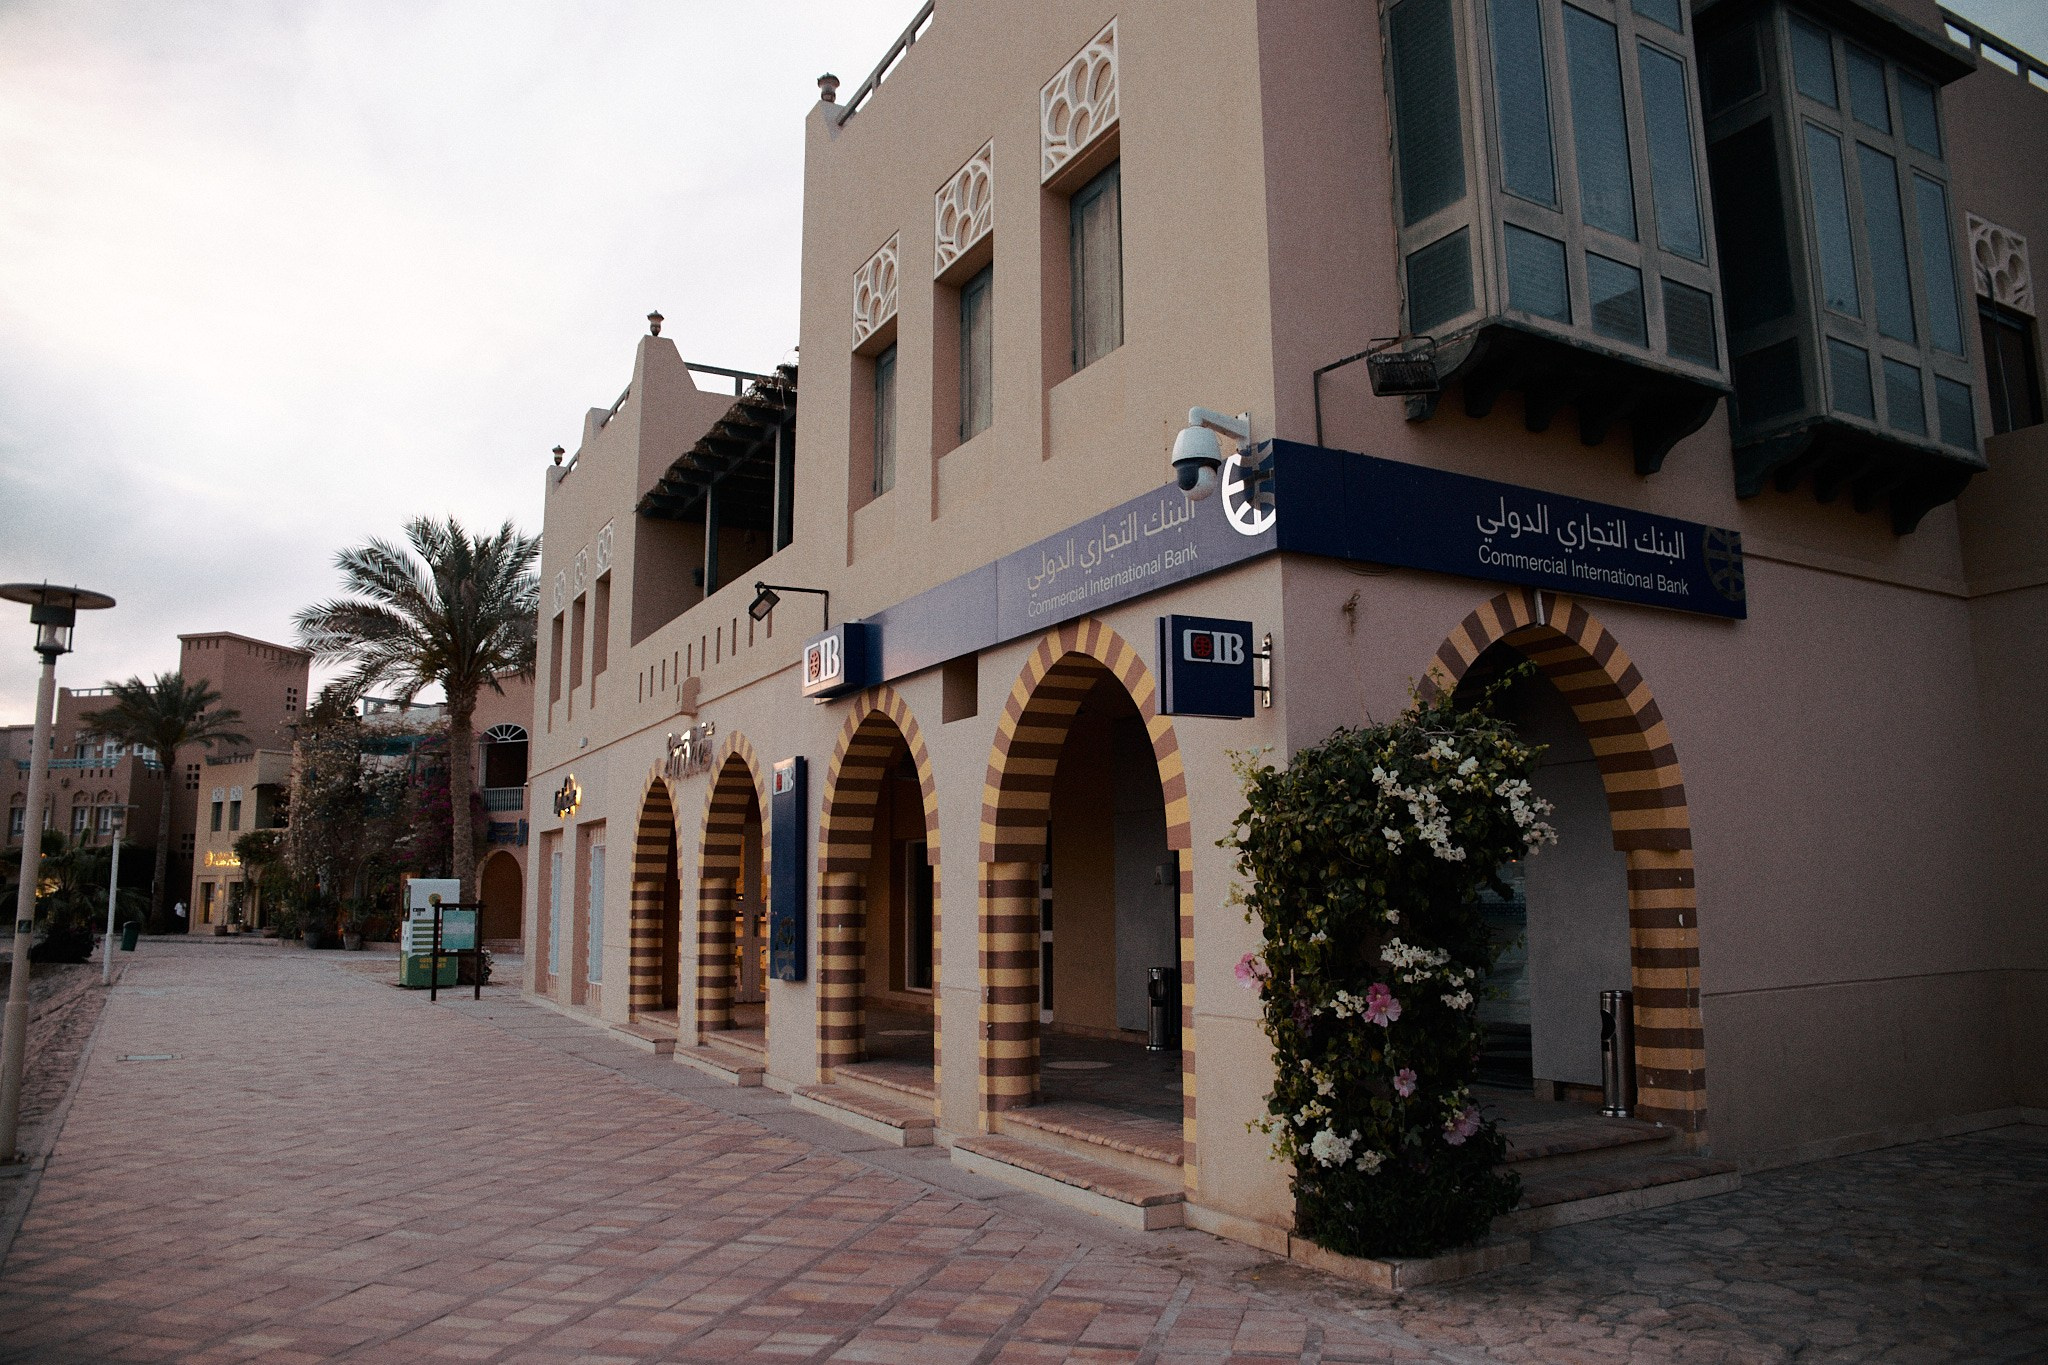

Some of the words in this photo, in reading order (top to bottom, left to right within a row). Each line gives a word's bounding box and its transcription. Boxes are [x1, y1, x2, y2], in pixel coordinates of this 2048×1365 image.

[1144, 496, 1195, 537] البنك
[1476, 496, 1549, 543] الدولي
[1557, 513, 1627, 553] التجاري
[1080, 511, 1138, 574] التجاري
[1634, 526, 1686, 565] البنك
[1027, 538, 1075, 597] الدولي
[1028, 586, 1088, 618] Commercial
[1090, 558, 1161, 592] International
[1165, 541, 1199, 570] Bank
[1478, 544, 1567, 576] Commercial
[1571, 559, 1654, 590] International
[1657, 574, 1690, 596] Bank
